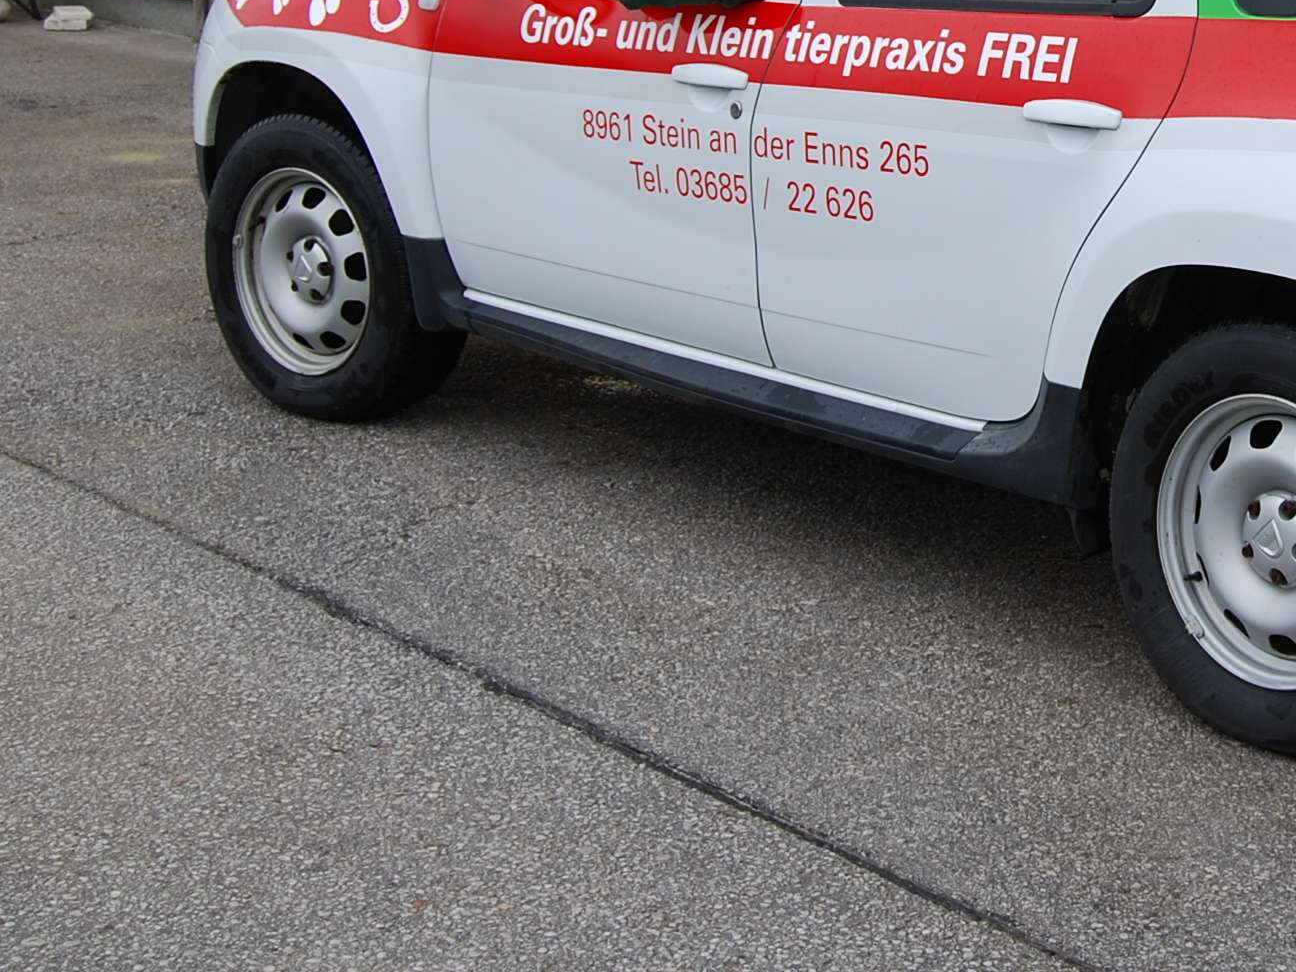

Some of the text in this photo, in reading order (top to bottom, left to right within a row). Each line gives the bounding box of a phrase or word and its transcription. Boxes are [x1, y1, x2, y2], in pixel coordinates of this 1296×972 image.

[520, 3, 1079, 84] Groß- und Klein tierpraxis FREI
[582, 109, 930, 177] 8961 Stein an der Enns 265
[629, 160, 669, 194] Tel.
[675, 167, 748, 205] 03685
[786, 180, 818, 214] 22
[825, 186, 875, 222] 626
